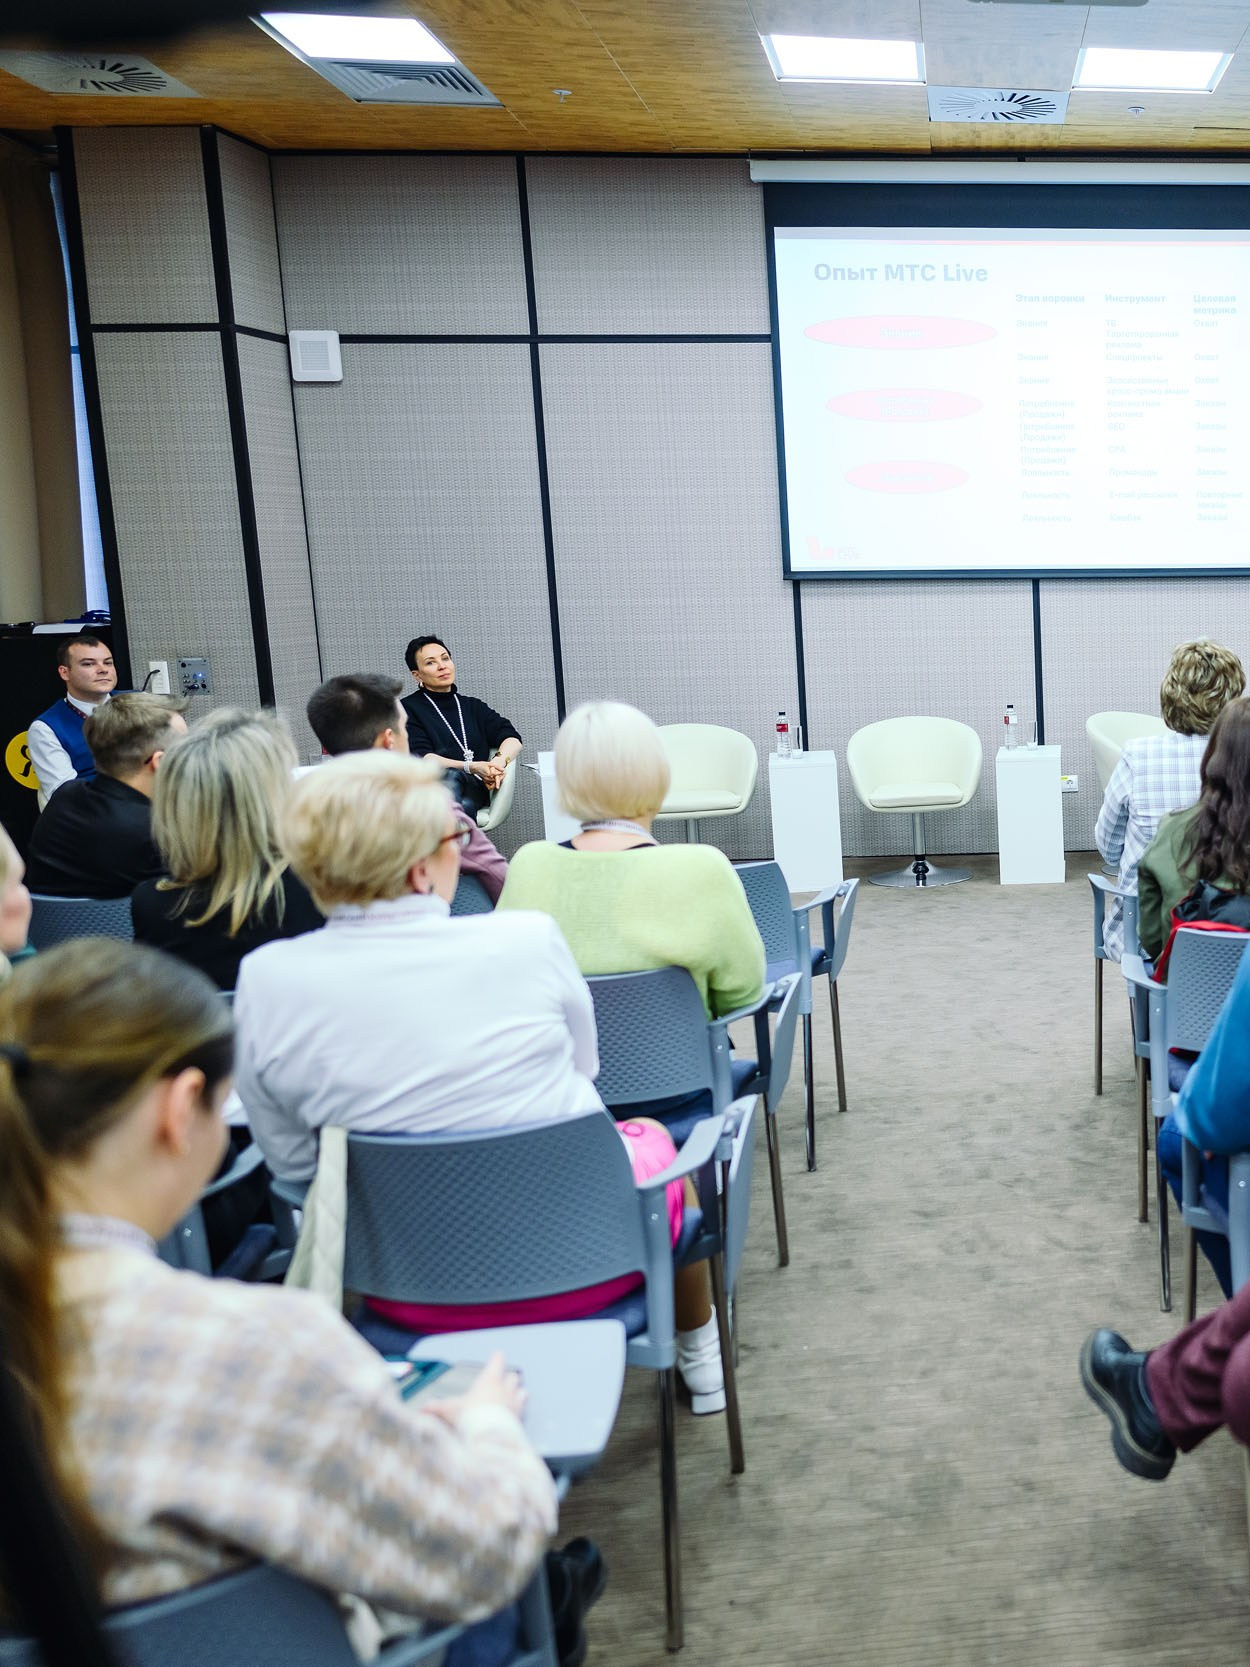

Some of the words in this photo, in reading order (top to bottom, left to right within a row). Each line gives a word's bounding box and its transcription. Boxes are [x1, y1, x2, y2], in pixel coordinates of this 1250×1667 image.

[814, 263, 878, 281] Опыт
[884, 263, 936, 281] МТС
[943, 263, 988, 282] Live
[1015, 294, 1040, 303] Этап
[1105, 294, 1166, 304] Инструмент
